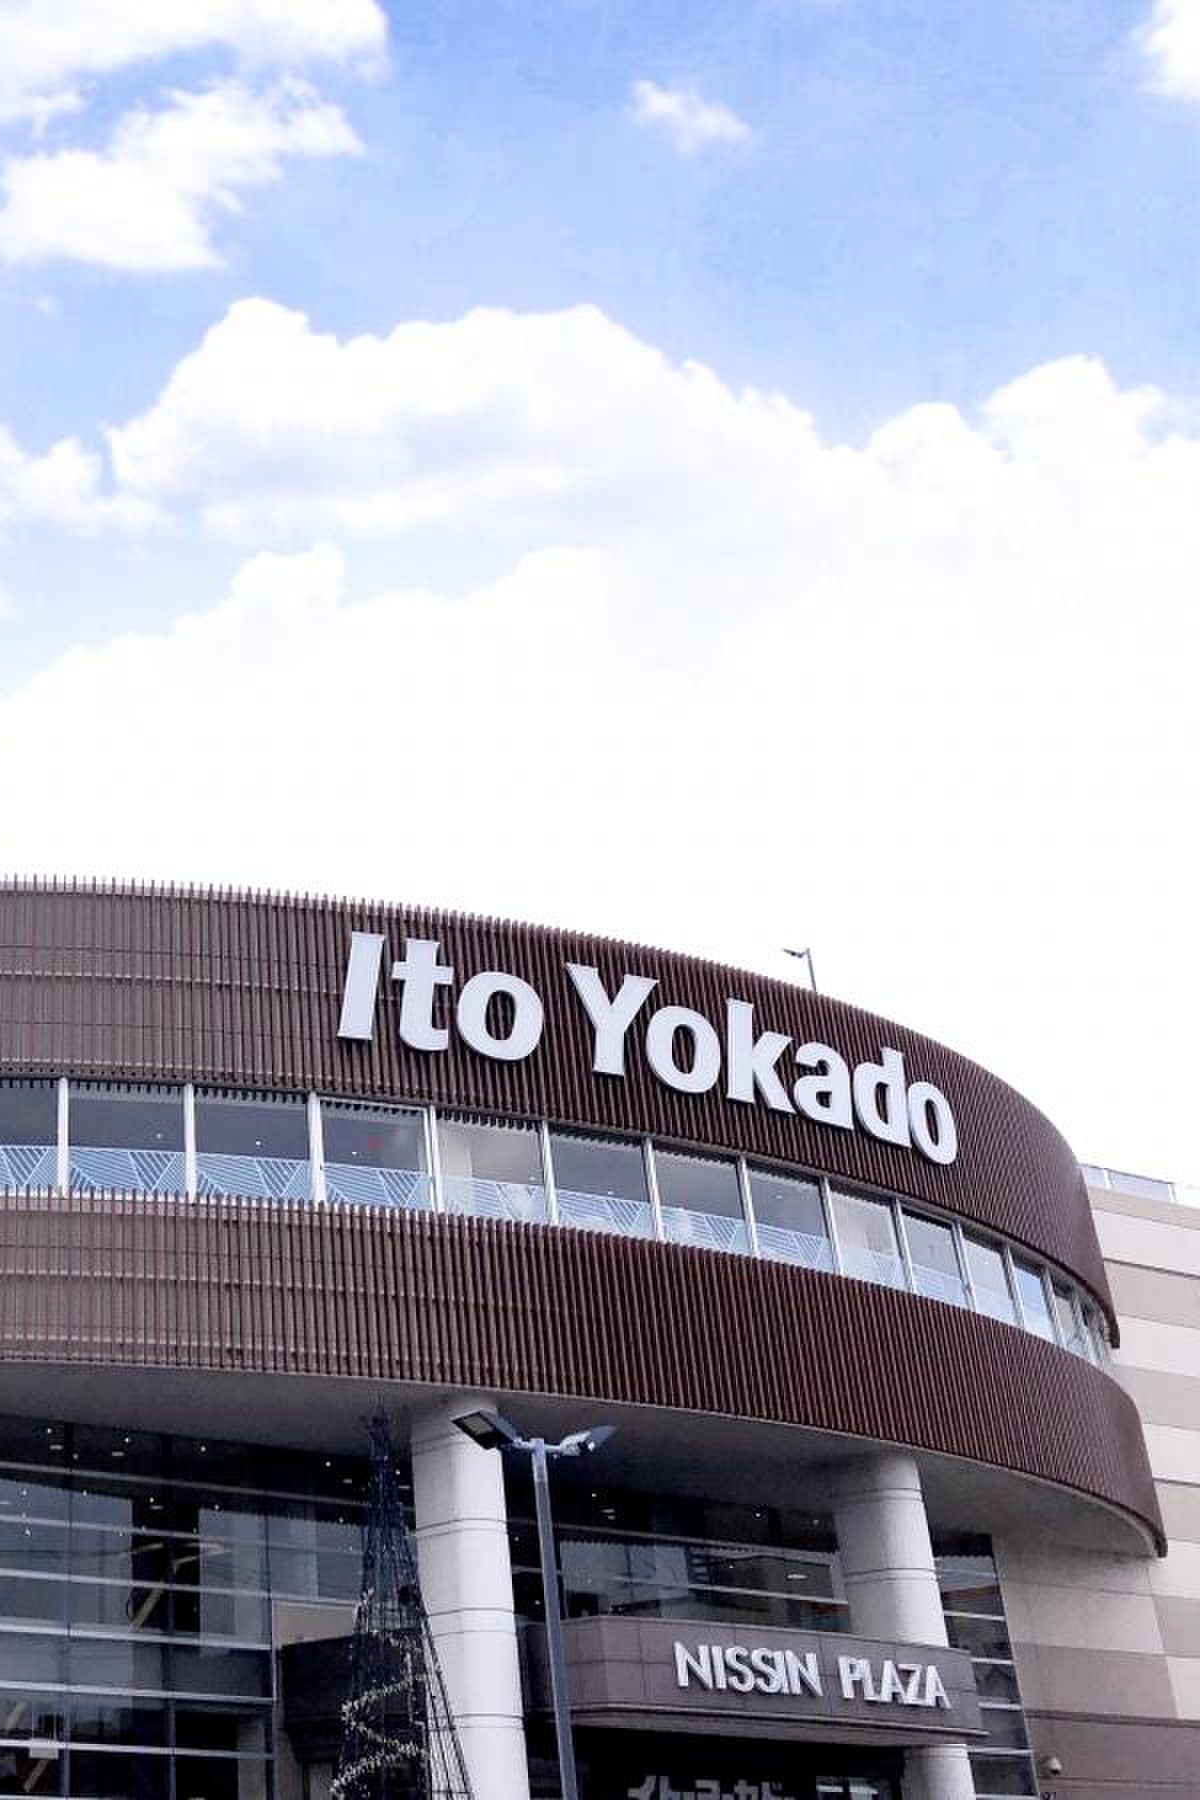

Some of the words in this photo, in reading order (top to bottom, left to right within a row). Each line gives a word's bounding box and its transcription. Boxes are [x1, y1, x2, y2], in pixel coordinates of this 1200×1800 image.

[337, 930, 544, 1062] Ito
[565, 961, 957, 1166] Yokado
[674, 1641, 823, 1697] NISSIN
[838, 1655, 951, 1710] PLAZA
